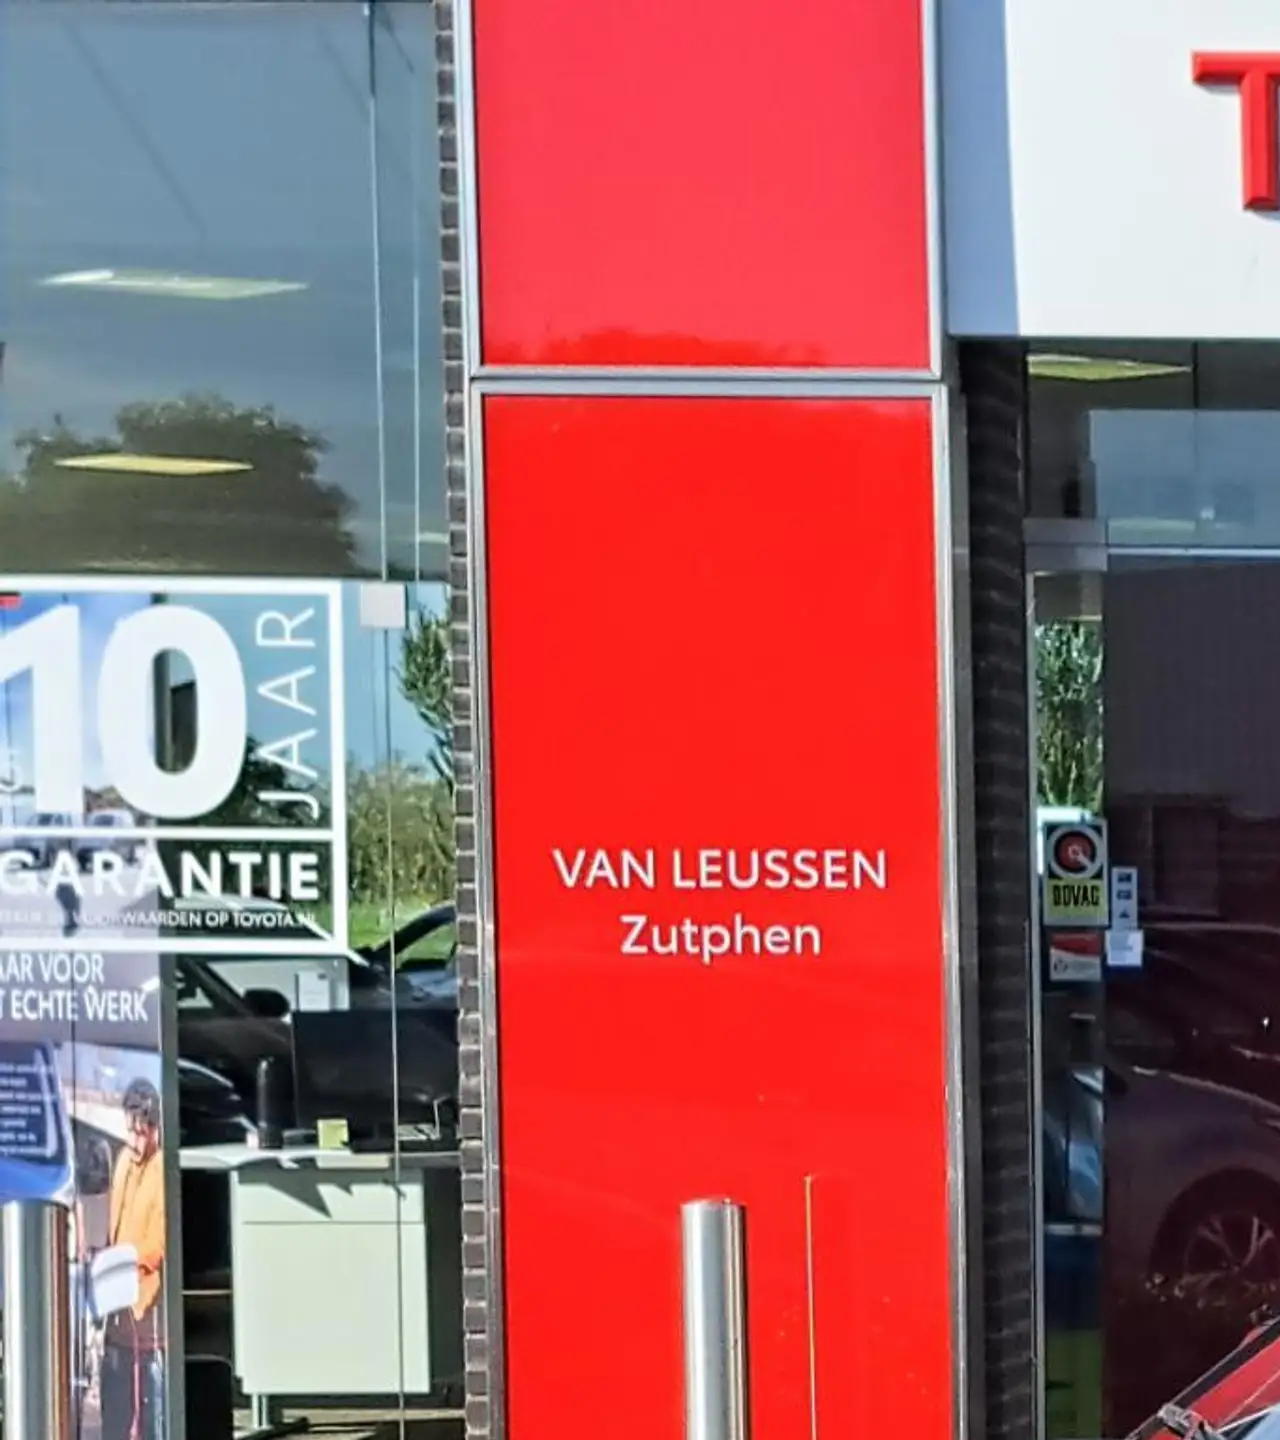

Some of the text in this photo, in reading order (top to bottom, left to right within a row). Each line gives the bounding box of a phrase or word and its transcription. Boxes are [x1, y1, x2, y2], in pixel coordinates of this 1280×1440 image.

[0, 603, 247, 820] 10
[256, 606, 319, 820] JAAR
[0, 850, 320, 900] GARANTIE
[552, 849, 887, 888] VAN LEUSSEN
[205, 911, 229, 928] OP
[619, 913, 821, 964] Zutphen
[38, 953, 105, 984] VOOR
[11, 990, 79, 1021] ECHTE
[84, 988, 149, 1022] WERK
